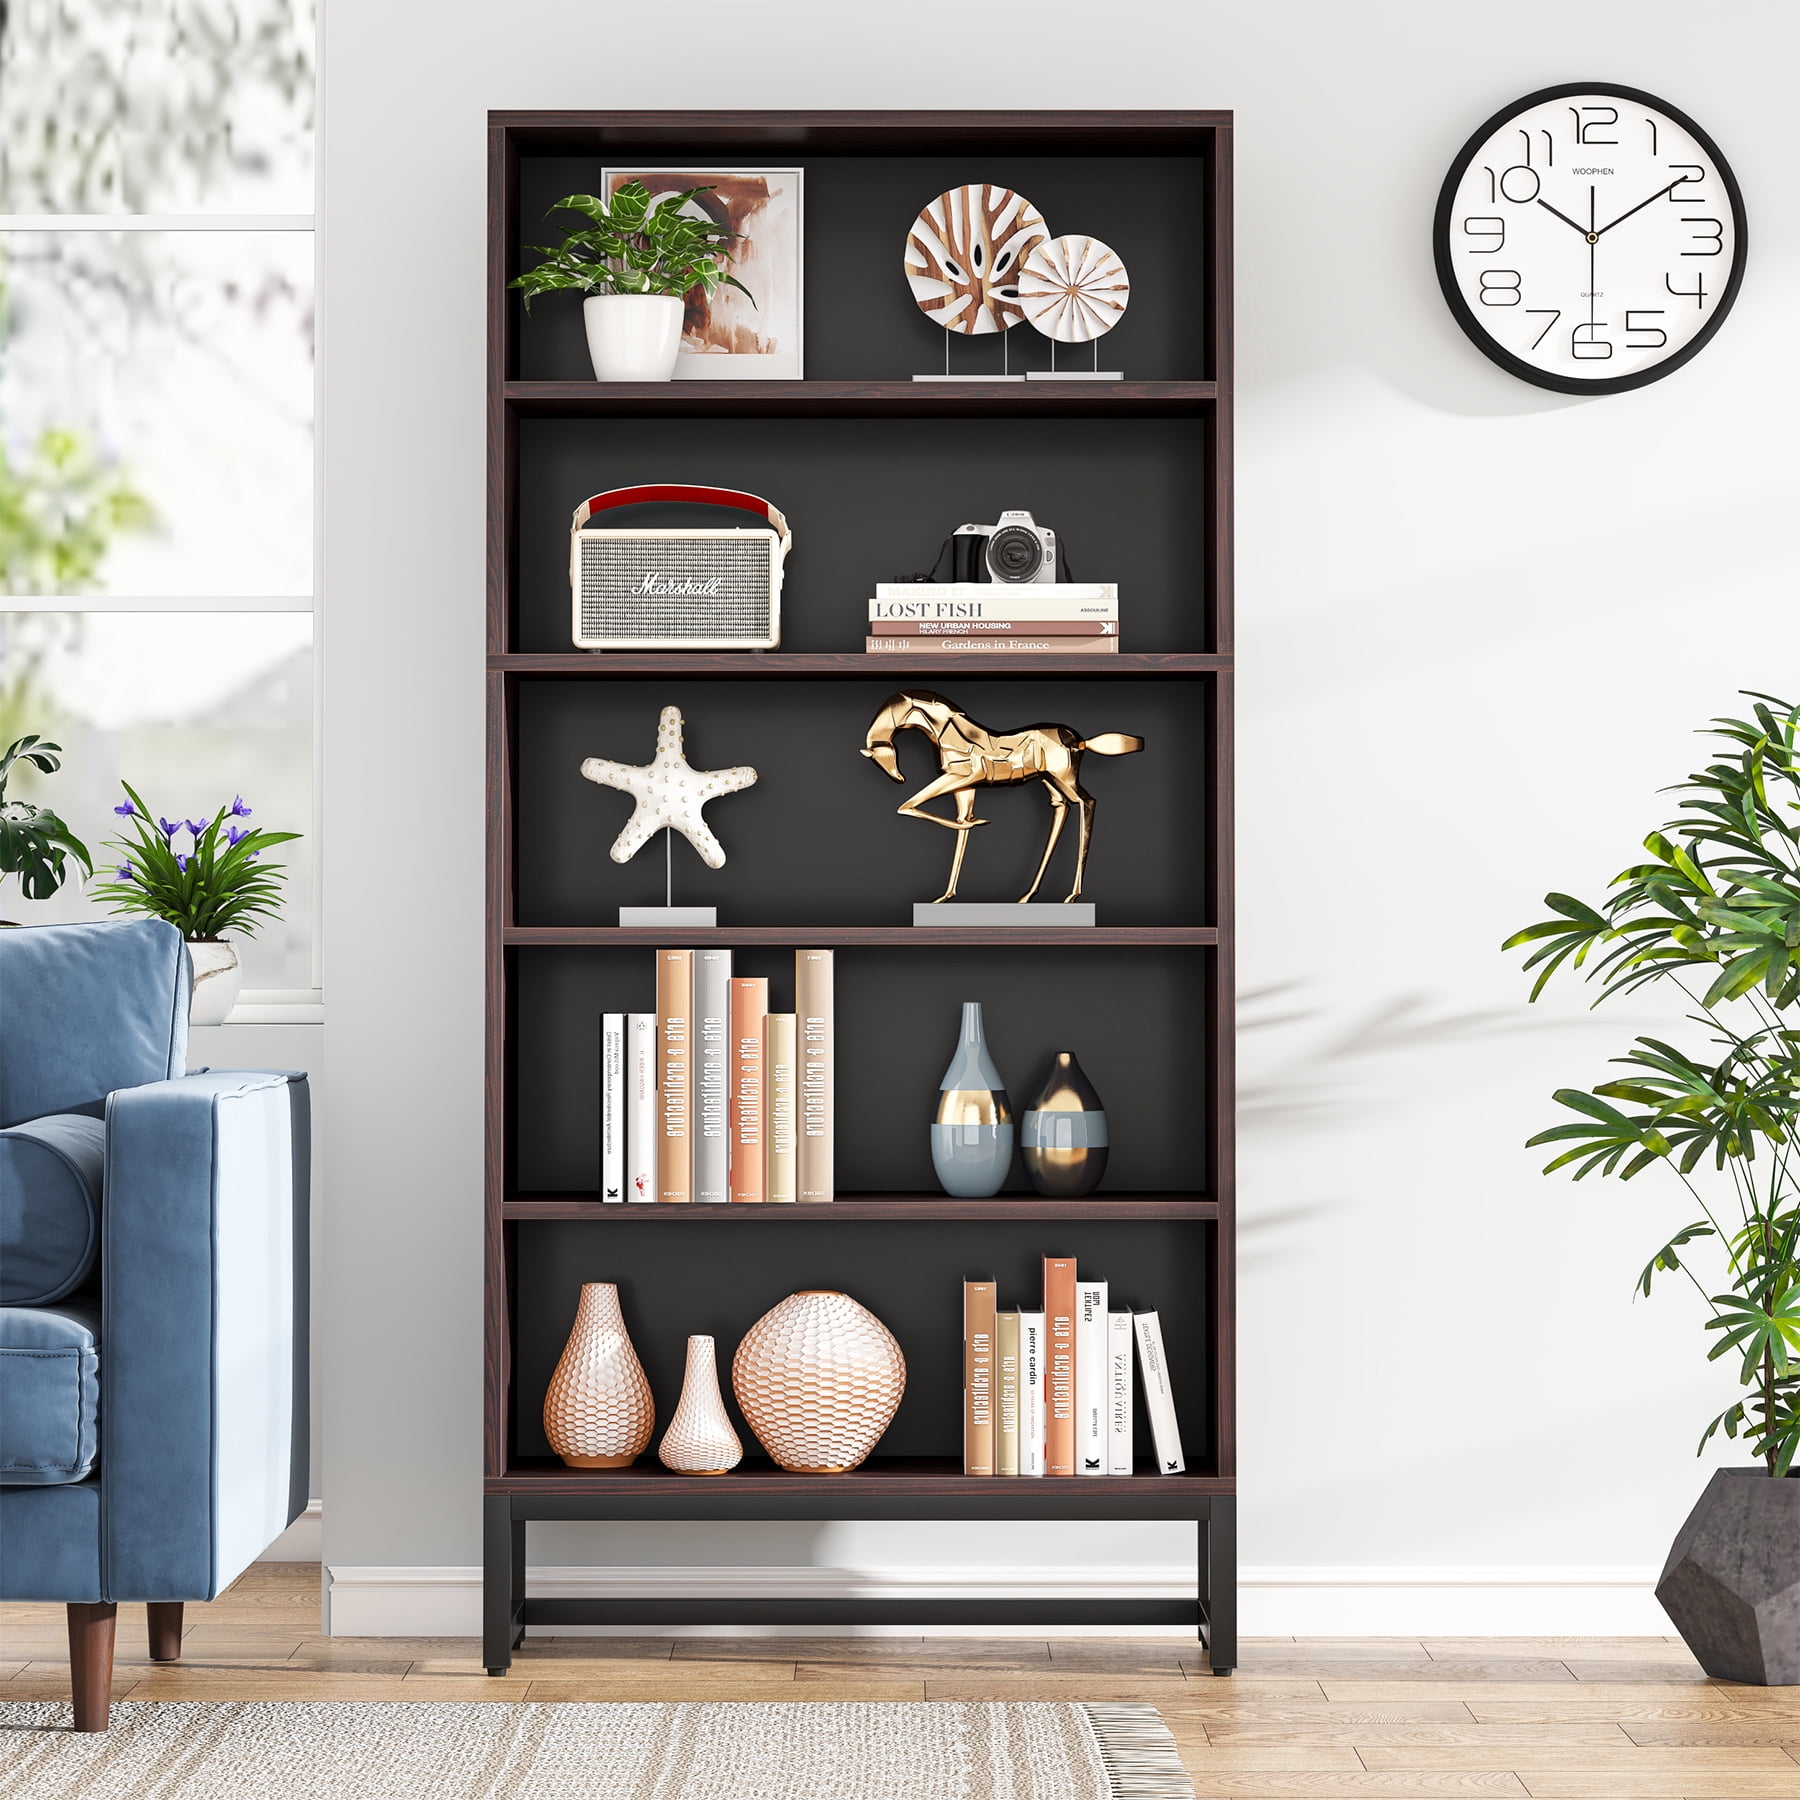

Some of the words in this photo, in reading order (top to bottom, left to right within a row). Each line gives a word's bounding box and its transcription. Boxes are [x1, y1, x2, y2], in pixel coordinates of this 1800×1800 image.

[1569, 107, 1618, 144] 12
[1646, 119, 1656, 156] 1
[1519, 130, 1552, 166] 11
[1484, 166, 1540, 203] 10
[1668, 165, 1705, 202] 2
[1464, 217, 1504, 253] 9
[1681, 218, 1723, 255] 3
[1480, 270, 1521, 306] 8
[1666, 272, 1708, 309] 4
[1525, 310, 1560, 350] 7
[1572, 323, 1612, 359] 6
[1626, 310, 1667, 347] 5
[631, 571, 722, 595] Marshall
[876, 603, 930, 617] LOST
[936, 603, 982, 617] FISH
[942, 640, 991, 650] Gardens
[994, 640, 1005, 650] in
[1010, 640, 1049, 650] France
[1028, 1328, 1036, 1354] pierre
